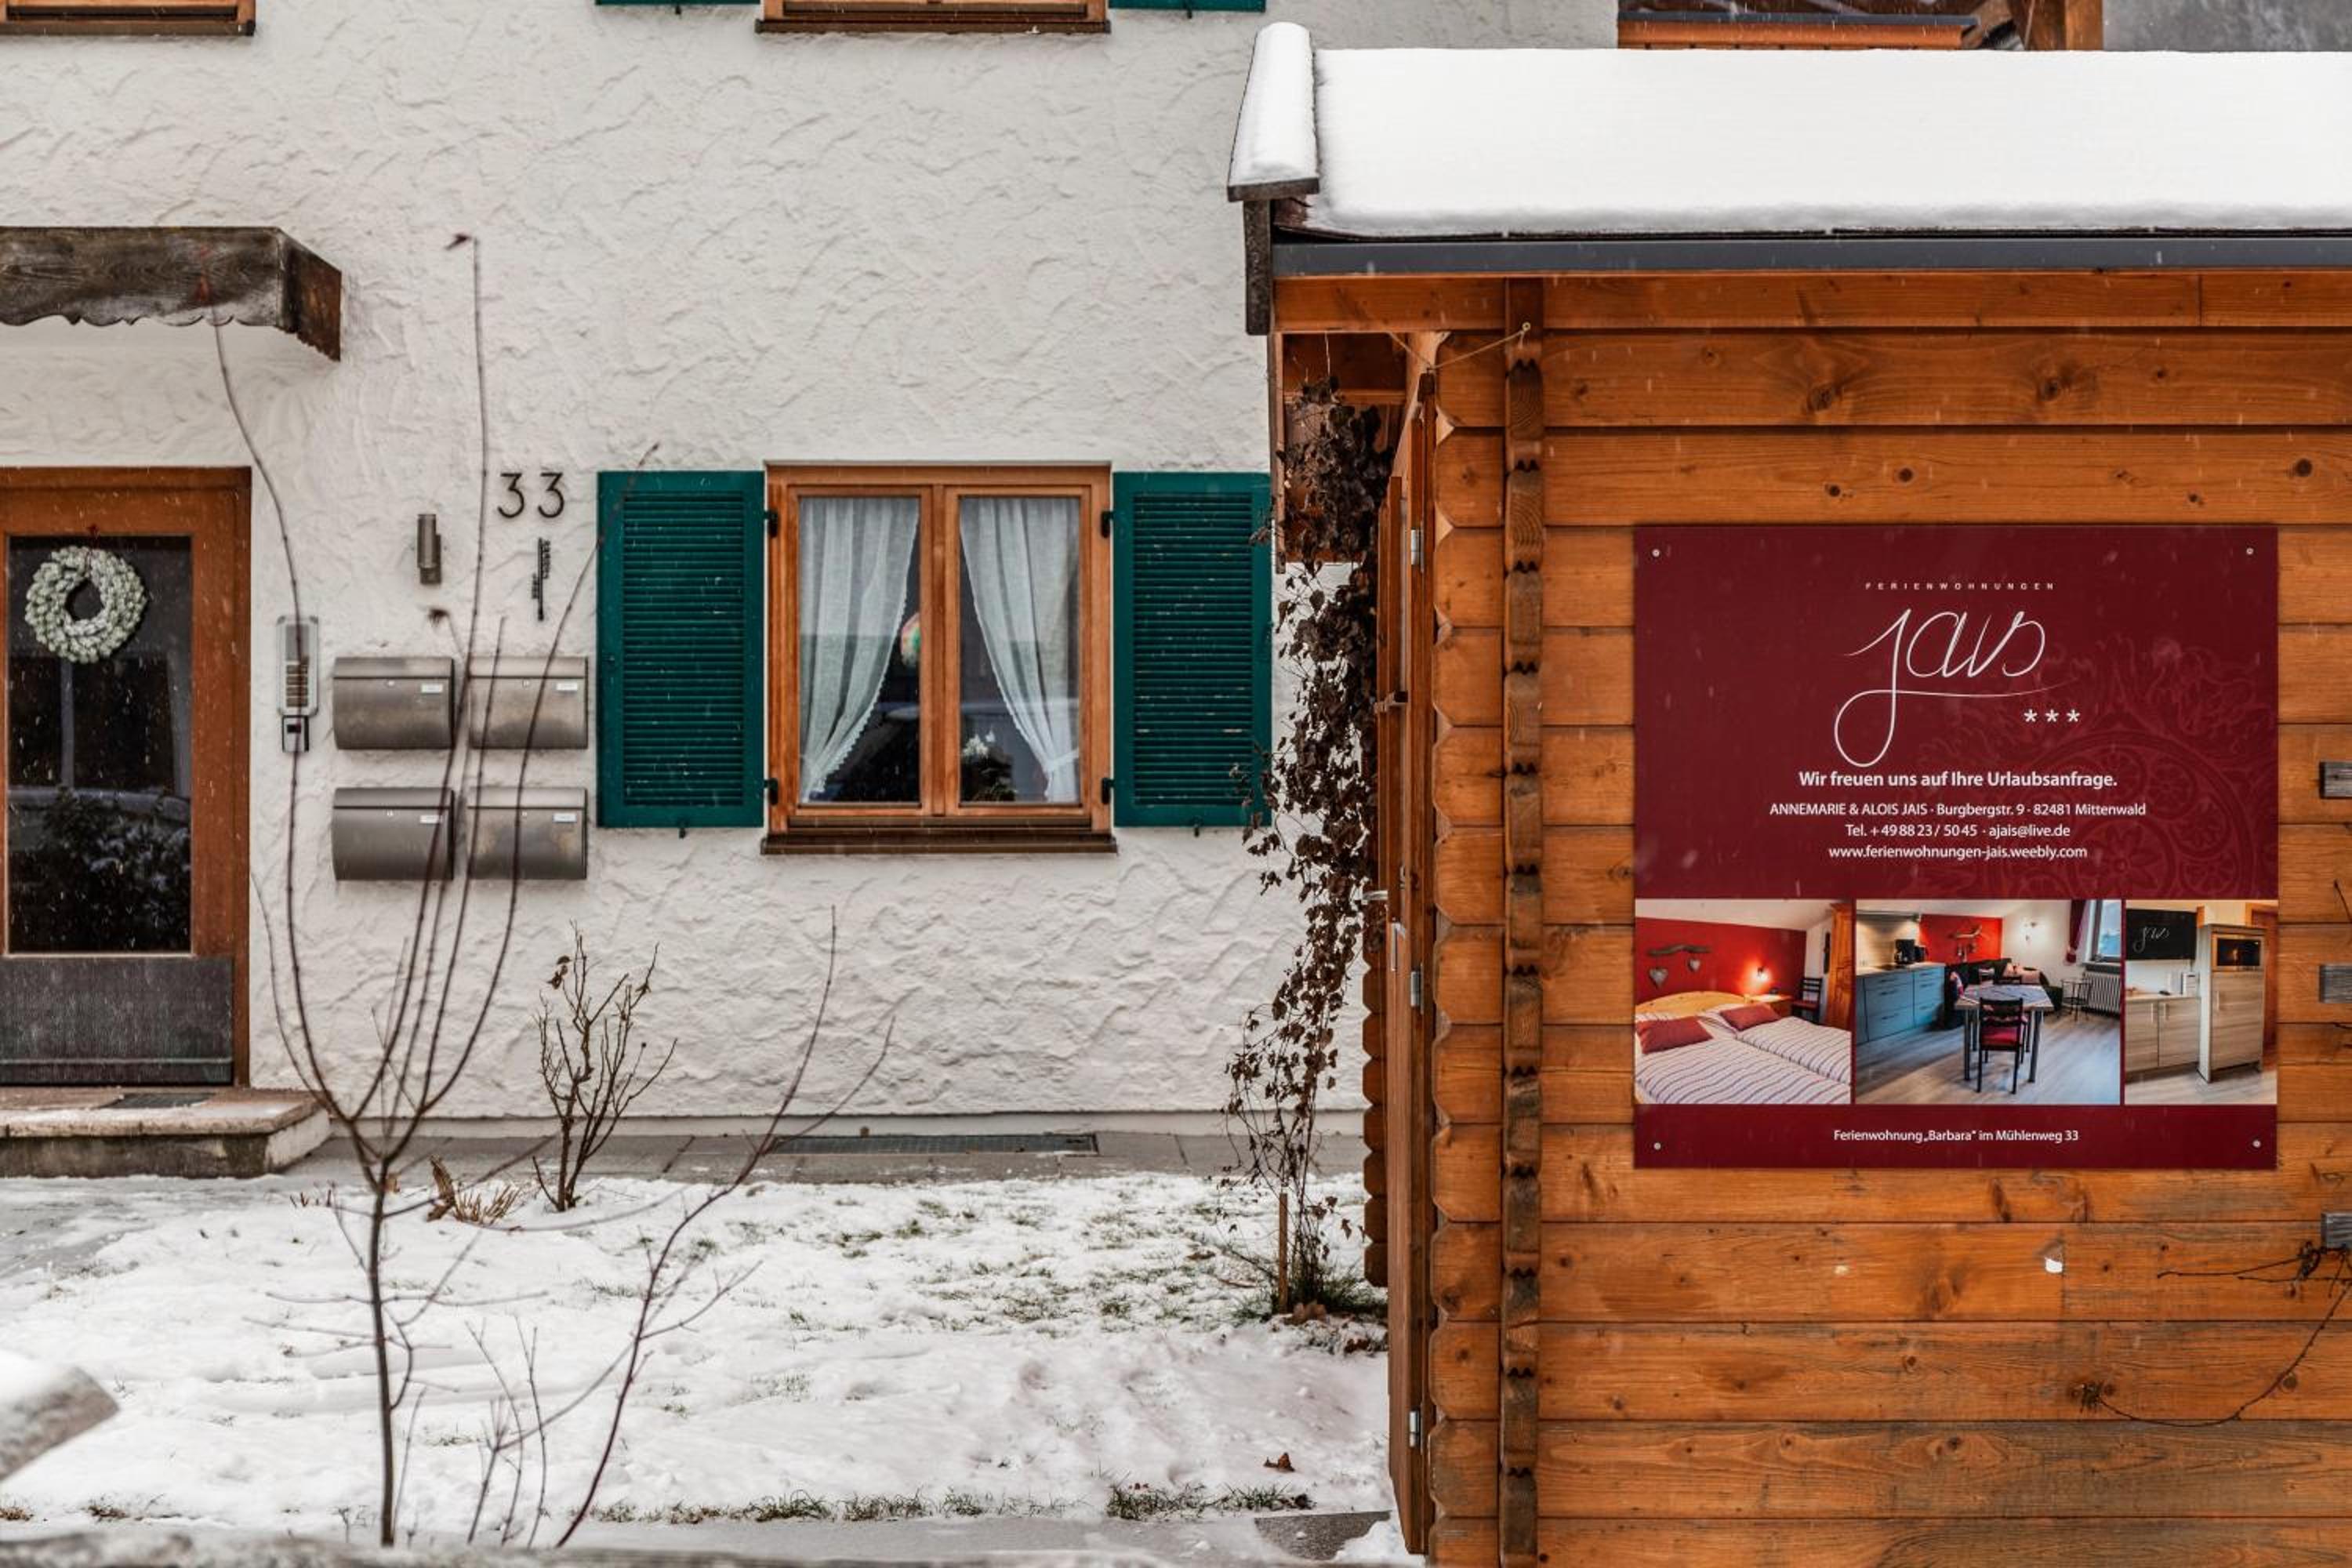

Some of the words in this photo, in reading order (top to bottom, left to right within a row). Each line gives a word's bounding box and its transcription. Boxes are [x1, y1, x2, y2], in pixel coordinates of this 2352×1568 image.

[497, 471, 565, 520] 33
[1864, 582, 2054, 590] FERIENWOHNUNGEN
[1798, 771, 1828, 786] Wir
[1830, 771, 1884, 786] freuen
[1888, 775, 1918, 786] uns
[1920, 771, 1948, 786] auf
[1951, 771, 1984, 786] Ihre
[1987, 771, 2118, 790] Urlaubsanfrage.
[1769, 802, 1846, 815] ANNEMARIE
[1849, 803, 1859, 815] &
[1860, 802, 1899, 815] ALOIS
[1901, 803, 1928, 816] JAIS
[1936, 802, 2014, 818] Burgbergstr.
[2016, 804, 2025, 815] 9
[2033, 804, 2071, 816] 82481
[2074, 802, 2147, 816] Mittenwald
[1845, 823, 1867, 837] Tel.
[1988, 823, 2071, 840] ajais@live.de
[1828, 844, 2088, 862] www.ferienwohnungen-jais.weebly.com
[1979, 1130, 1994, 1141] im
[1995, 1129, 2063, 1144] Mühlenweg
[2064, 1130, 2079, 1142] 33
